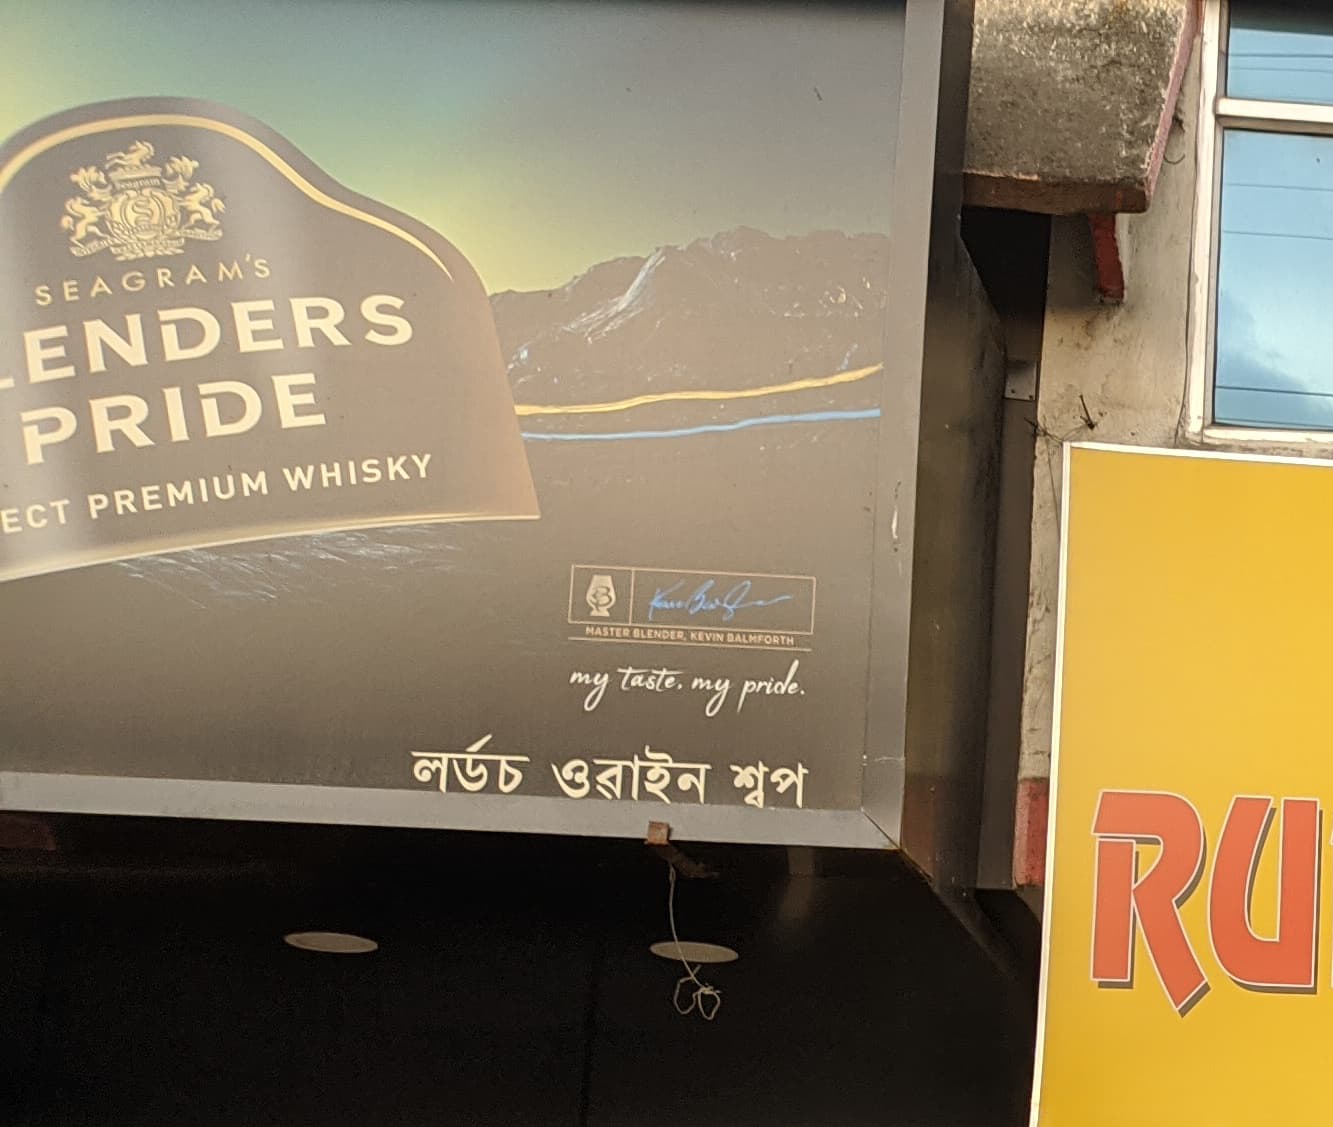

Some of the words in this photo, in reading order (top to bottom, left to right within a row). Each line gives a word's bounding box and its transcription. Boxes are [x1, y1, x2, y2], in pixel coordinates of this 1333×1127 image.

[36, 253, 271, 306] SEAGRAM'S
[19, 372, 326, 465] PRIDE
[88, 470, 268, 519] PREMIUM
[283, 453, 432, 492] WHISKY
[585, 626, 630, 638] MASTER
[633, 628, 687, 642] BLENDER,
[690, 631, 725, 643] KEVIN
[727, 632, 795, 646] BALMFORTH
[569, 669, 609, 712] my
[691, 674, 731, 718] my
[737, 659, 806, 714] pride.
